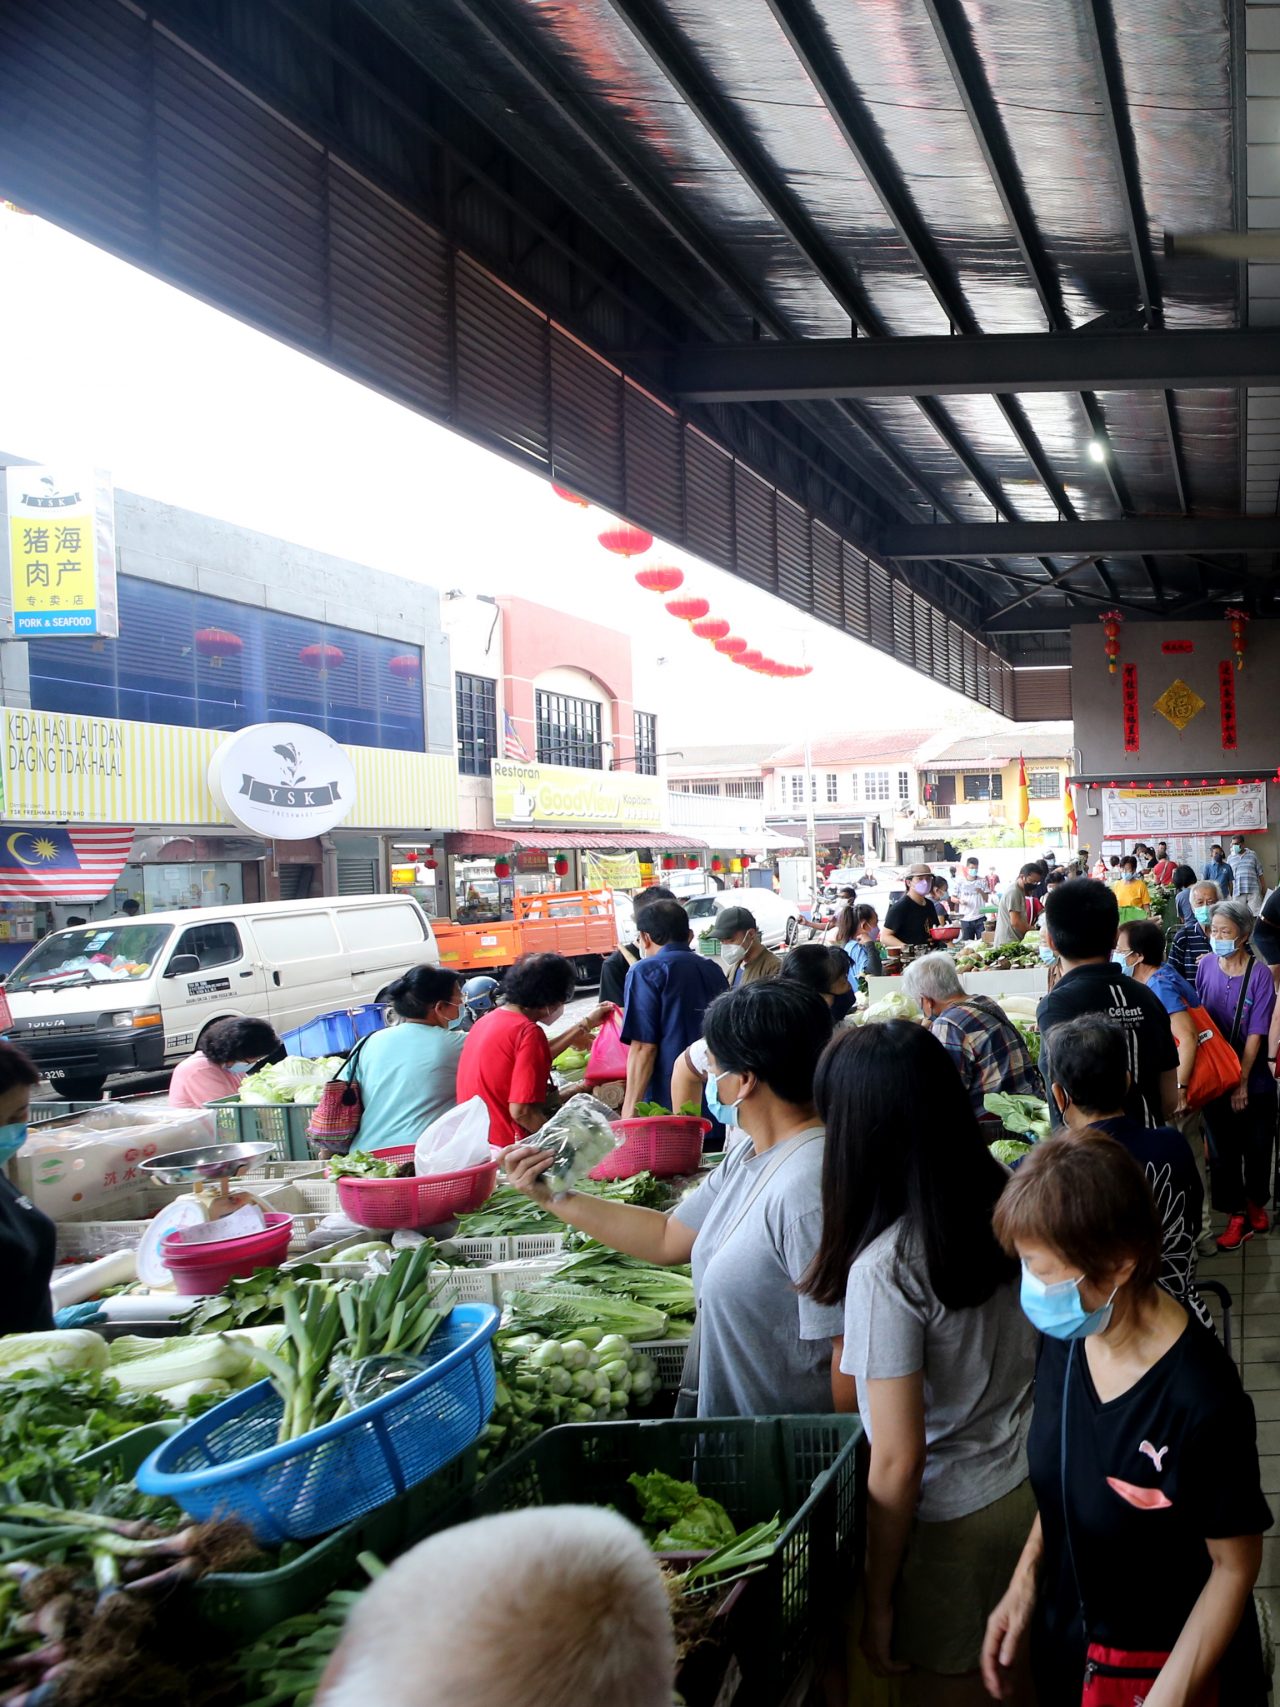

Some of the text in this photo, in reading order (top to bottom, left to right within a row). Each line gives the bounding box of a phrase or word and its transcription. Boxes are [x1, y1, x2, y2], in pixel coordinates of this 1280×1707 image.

[36, 498, 66, 507] YSK
[19, 618, 43, 628] PORK
[52, 616, 92, 627] SEAFOOD
[8, 714, 123, 748] KEDAI HASIL LAUT DAN
[9, 745, 122, 777] DAGING TIDAK-HALAL
[494, 763, 540, 780] Restoran
[268, 788, 316, 805] YSK
[539, 784, 620, 818] GoodView
[27, 1019, 66, 1029] TOYOTA
[44, 1069, 65, 1080] 3216
